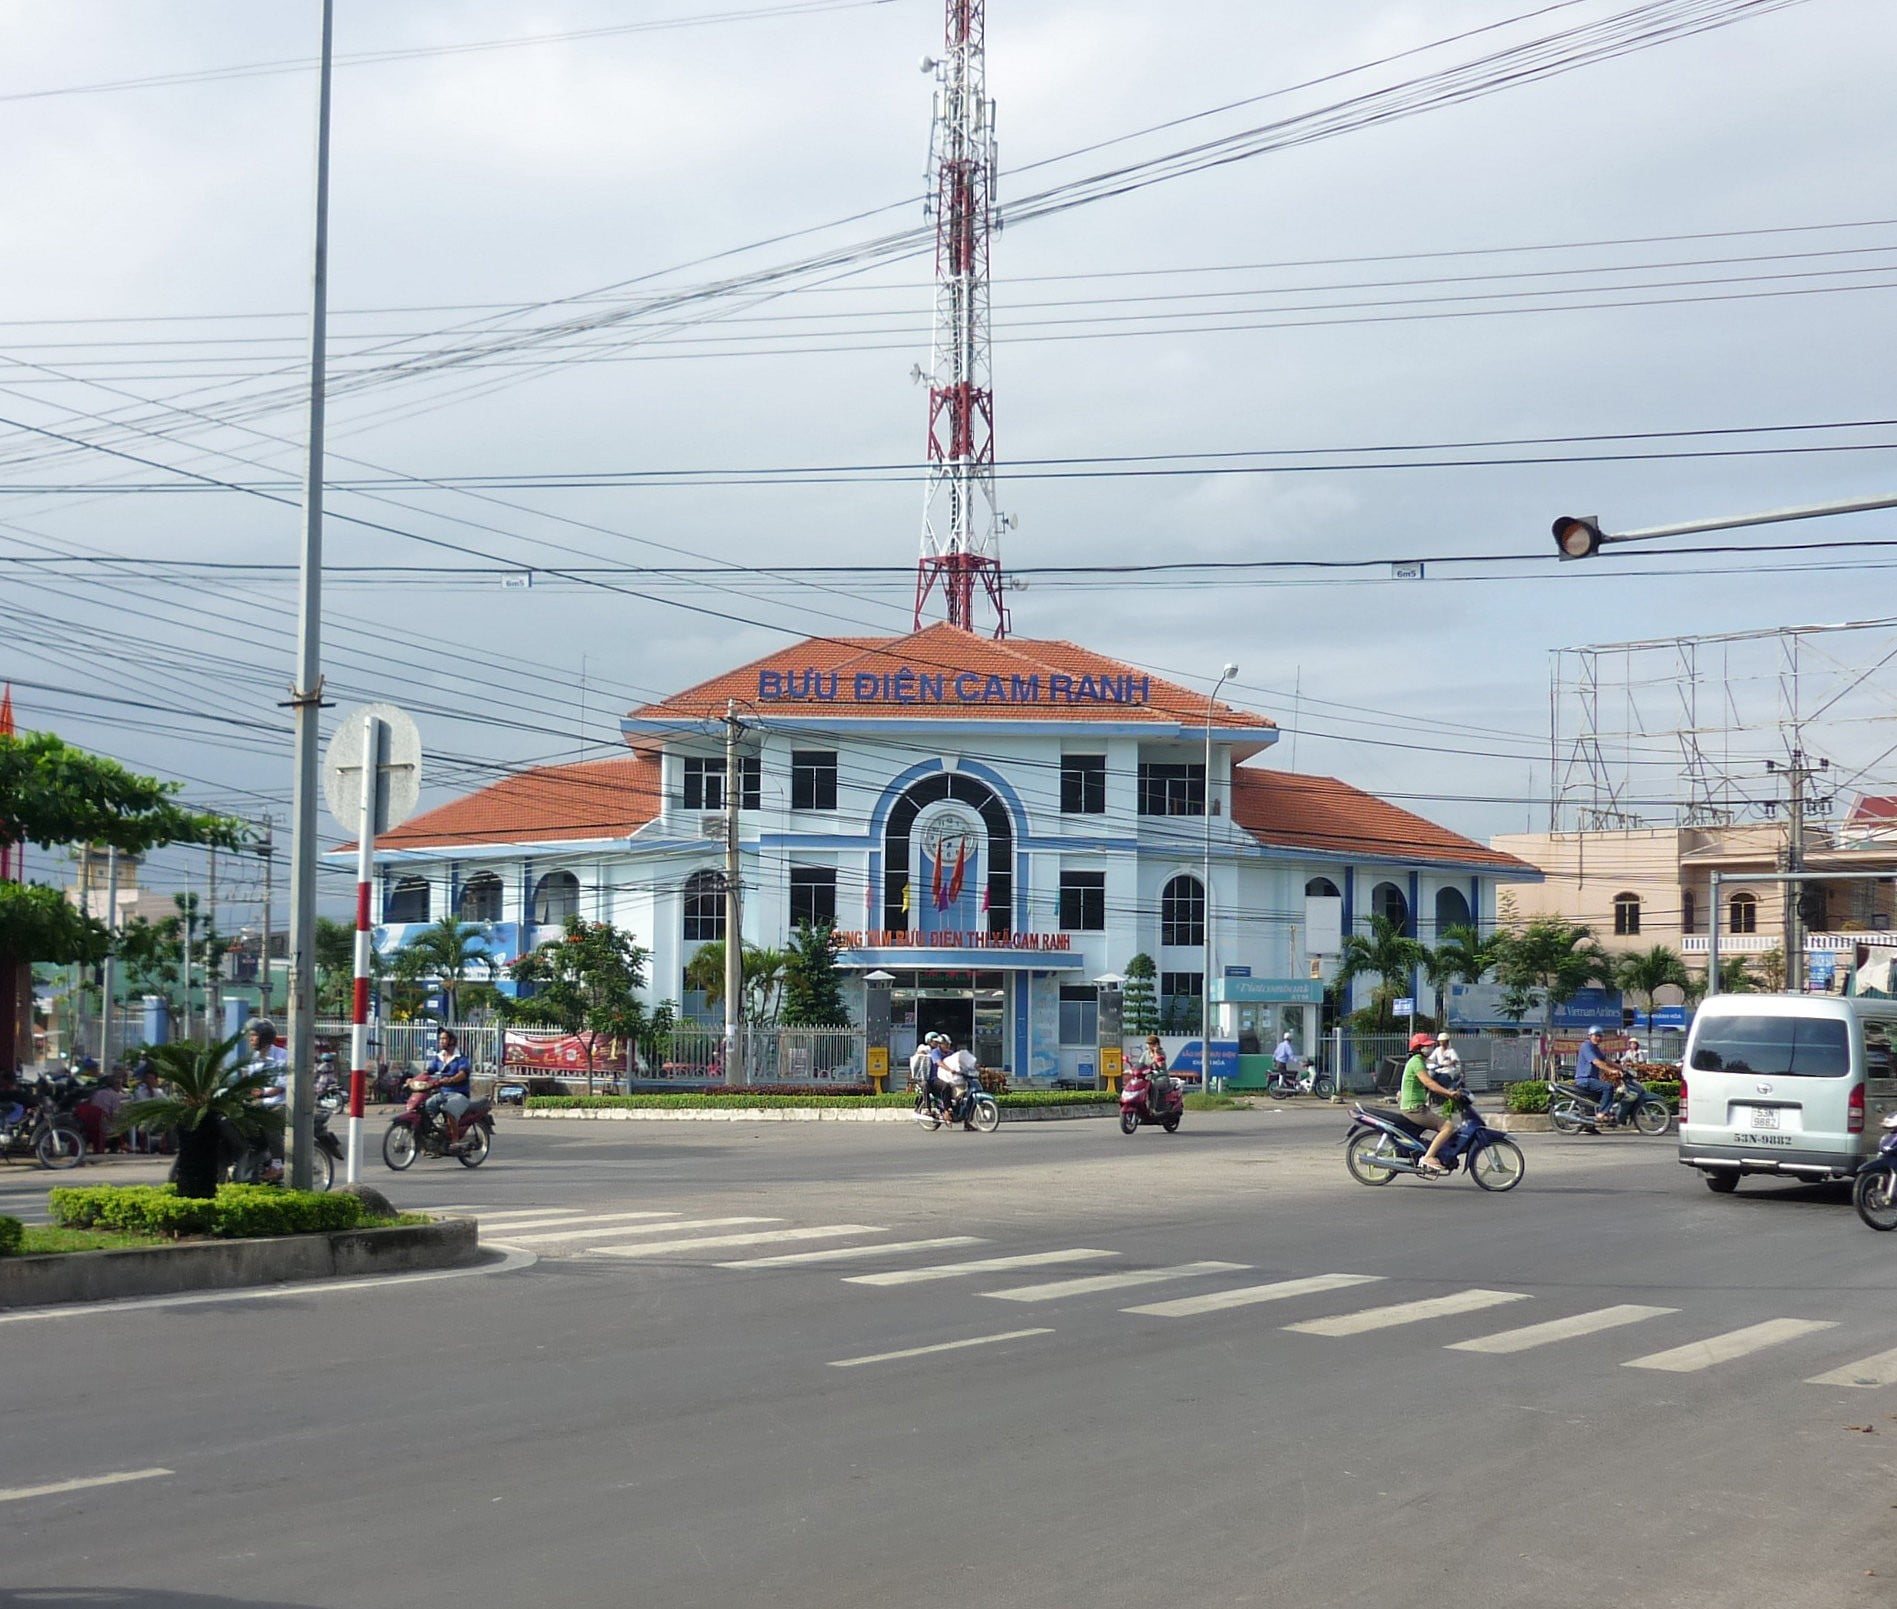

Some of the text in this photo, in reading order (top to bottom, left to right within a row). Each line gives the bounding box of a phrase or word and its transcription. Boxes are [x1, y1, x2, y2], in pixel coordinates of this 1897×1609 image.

[759, 666, 1149, 706] BƯU ĐIỆN CAM RANH
[1013, 932, 1039, 951] CAM
[1043, 934, 1071, 952] RANH
[1567, 1006, 1621, 1017] Vietnam Airlines
[1753, 1117, 1777, 1127] 9882
[1733, 1132, 1793, 1145] 53N-9882
